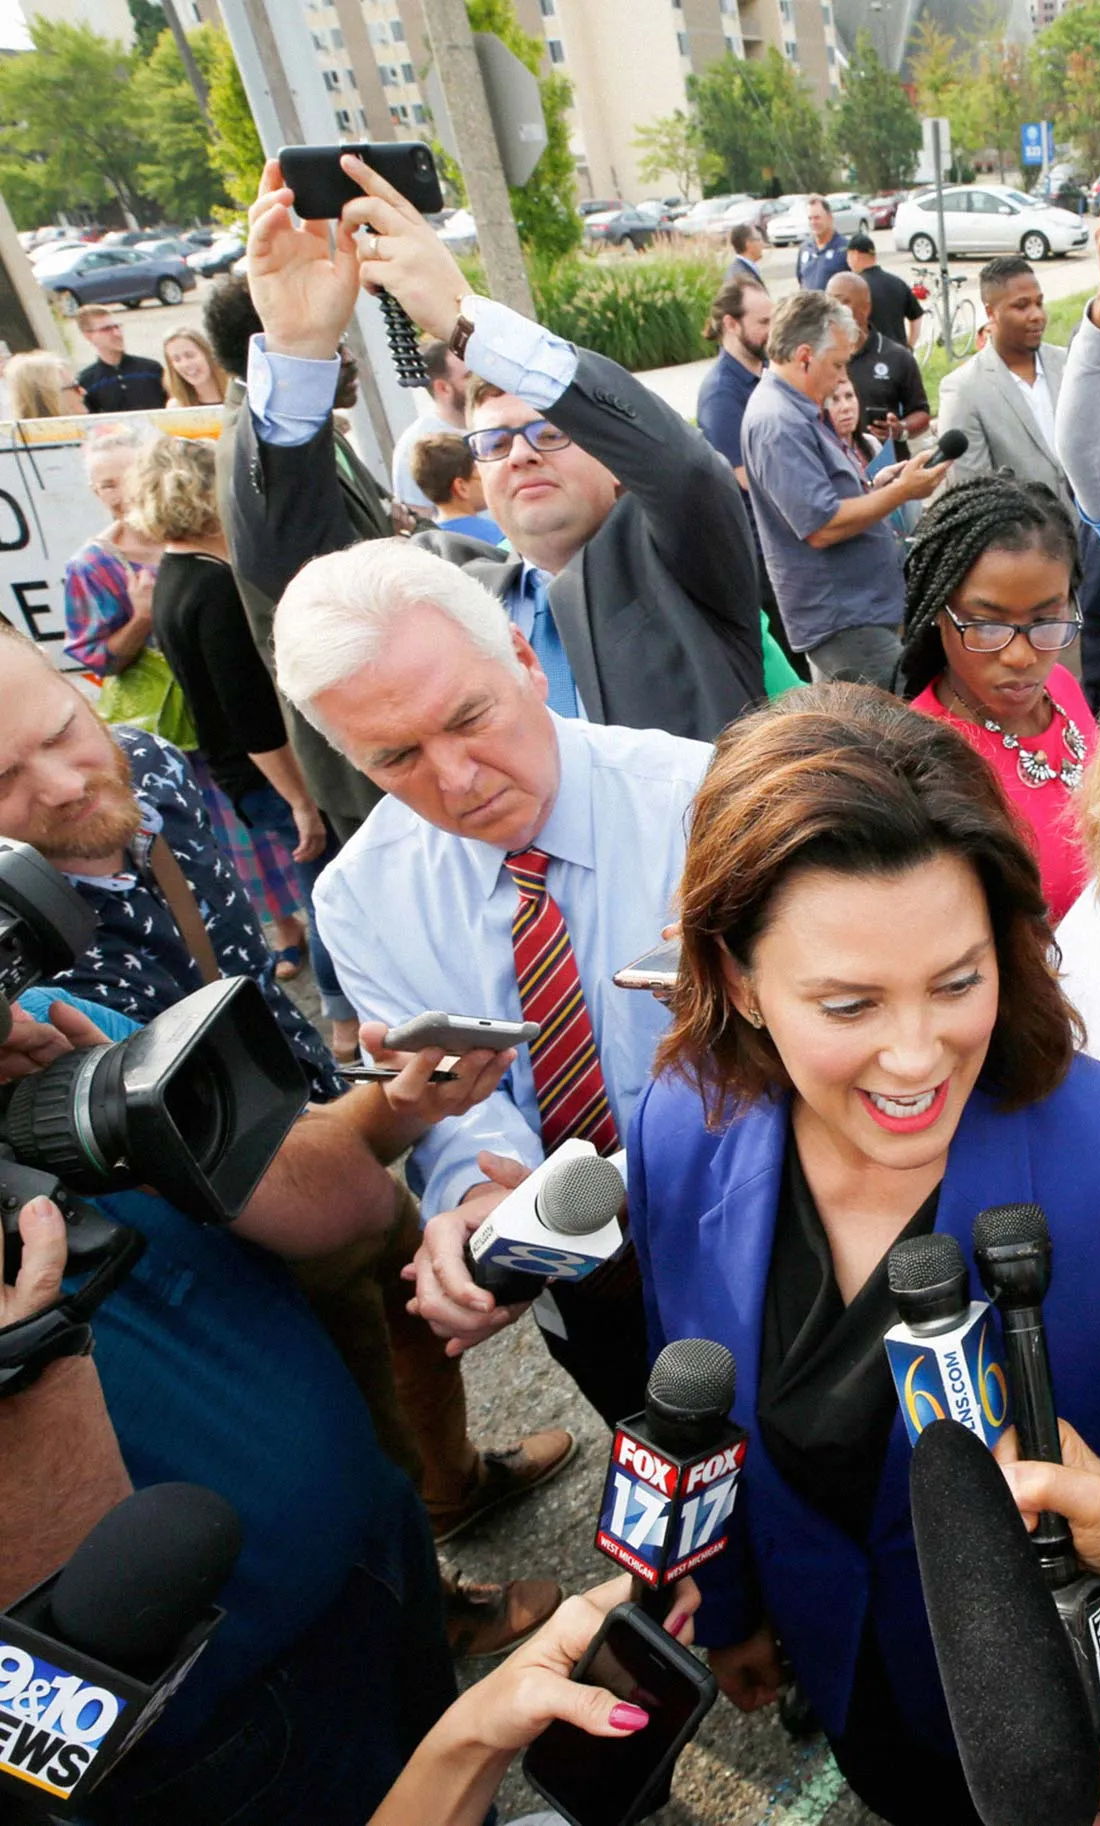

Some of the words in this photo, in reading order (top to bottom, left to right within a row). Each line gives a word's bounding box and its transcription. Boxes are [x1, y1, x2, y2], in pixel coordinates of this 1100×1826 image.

[904, 1355, 946, 1435] 6
[977, 1320, 1008, 1428] 6
[618, 1436, 672, 1494] FOX
[686, 1443, 742, 1494] FOX
[610, 1471, 672, 1550] 17
[677, 1468, 739, 1559] 17
[600, 1535, 620, 1555] WEST
[618, 1549, 654, 1581] MICHIGAN
[667, 1564, 686, 1581] WEST
[688, 1541, 724, 1570] MICHIGAN
[0, 1645, 119, 1743] 9&10
